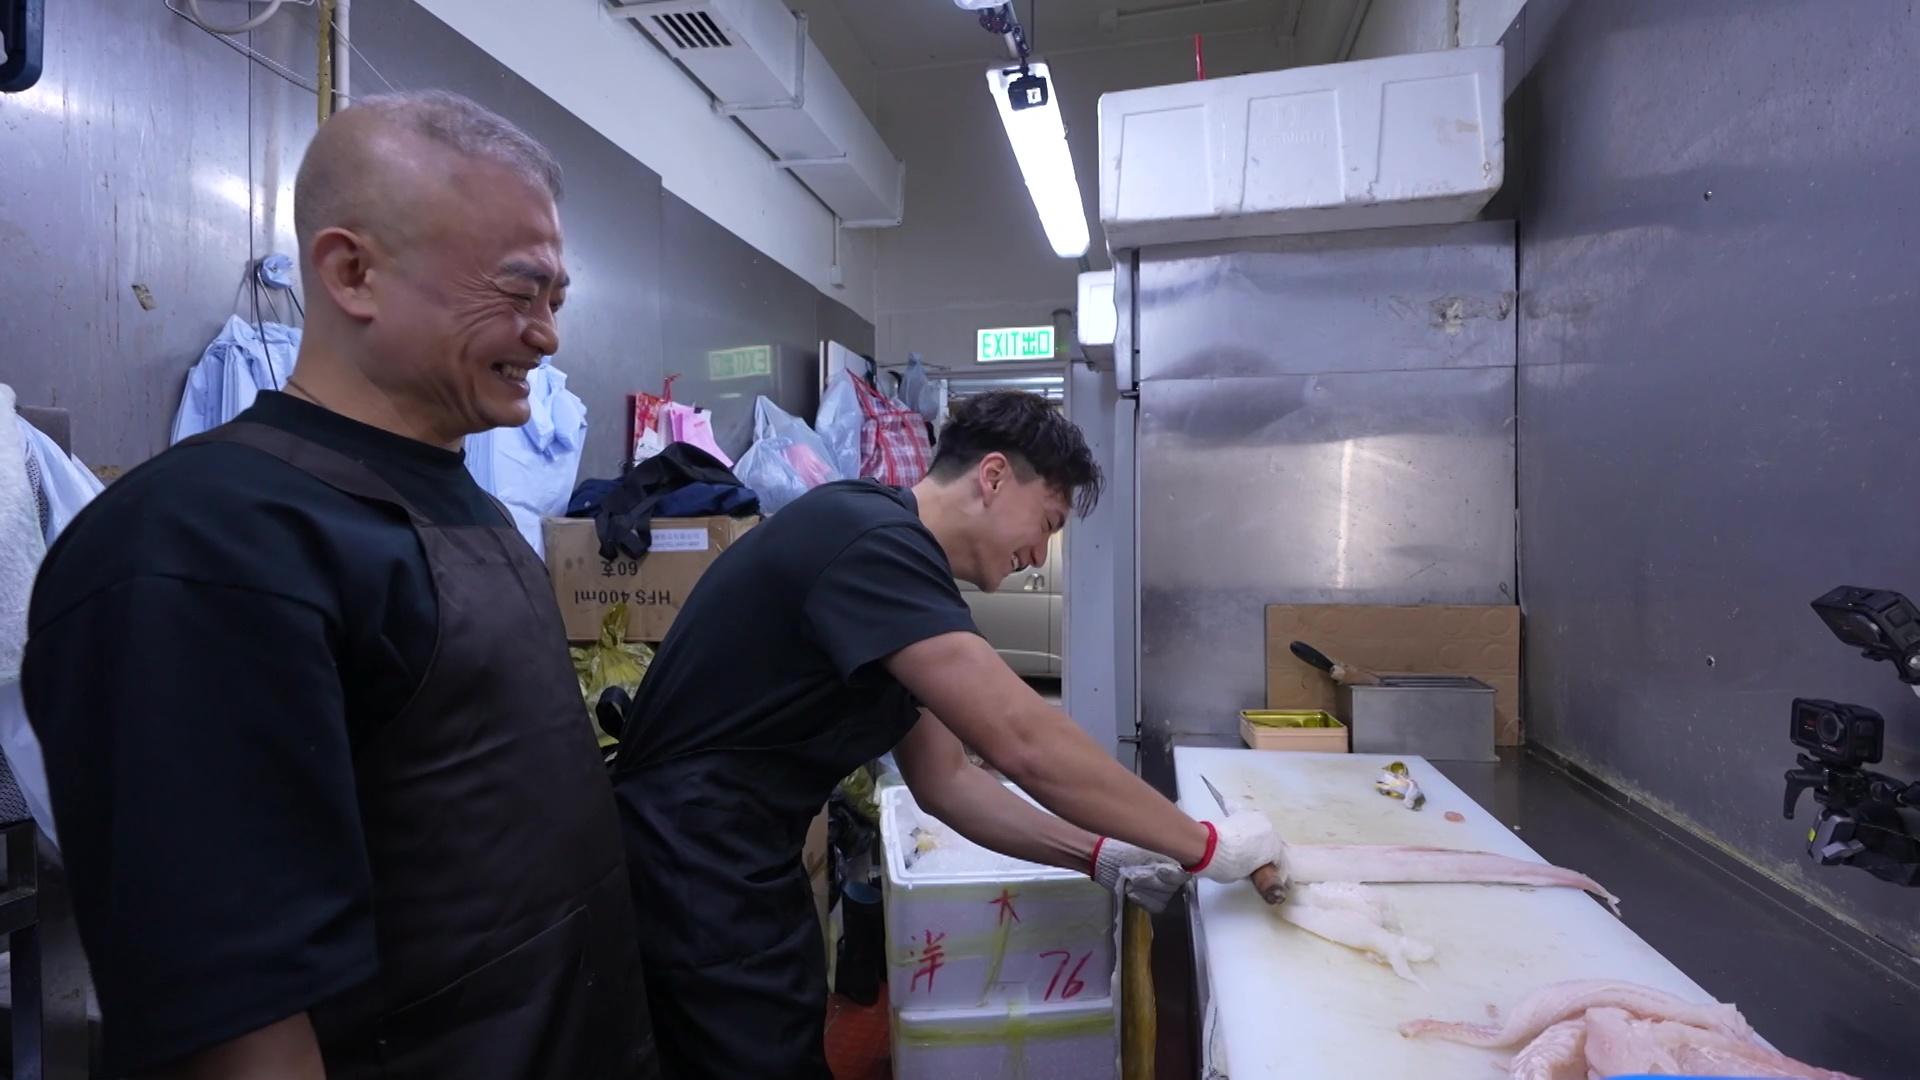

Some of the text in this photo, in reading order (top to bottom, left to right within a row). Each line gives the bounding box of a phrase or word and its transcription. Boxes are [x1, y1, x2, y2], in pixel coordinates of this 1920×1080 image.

[982, 330, 1050, 358] EXIT 出口
[575, 590, 671, 604] HFS 400ml
[1039, 949, 1094, 1002] 76
